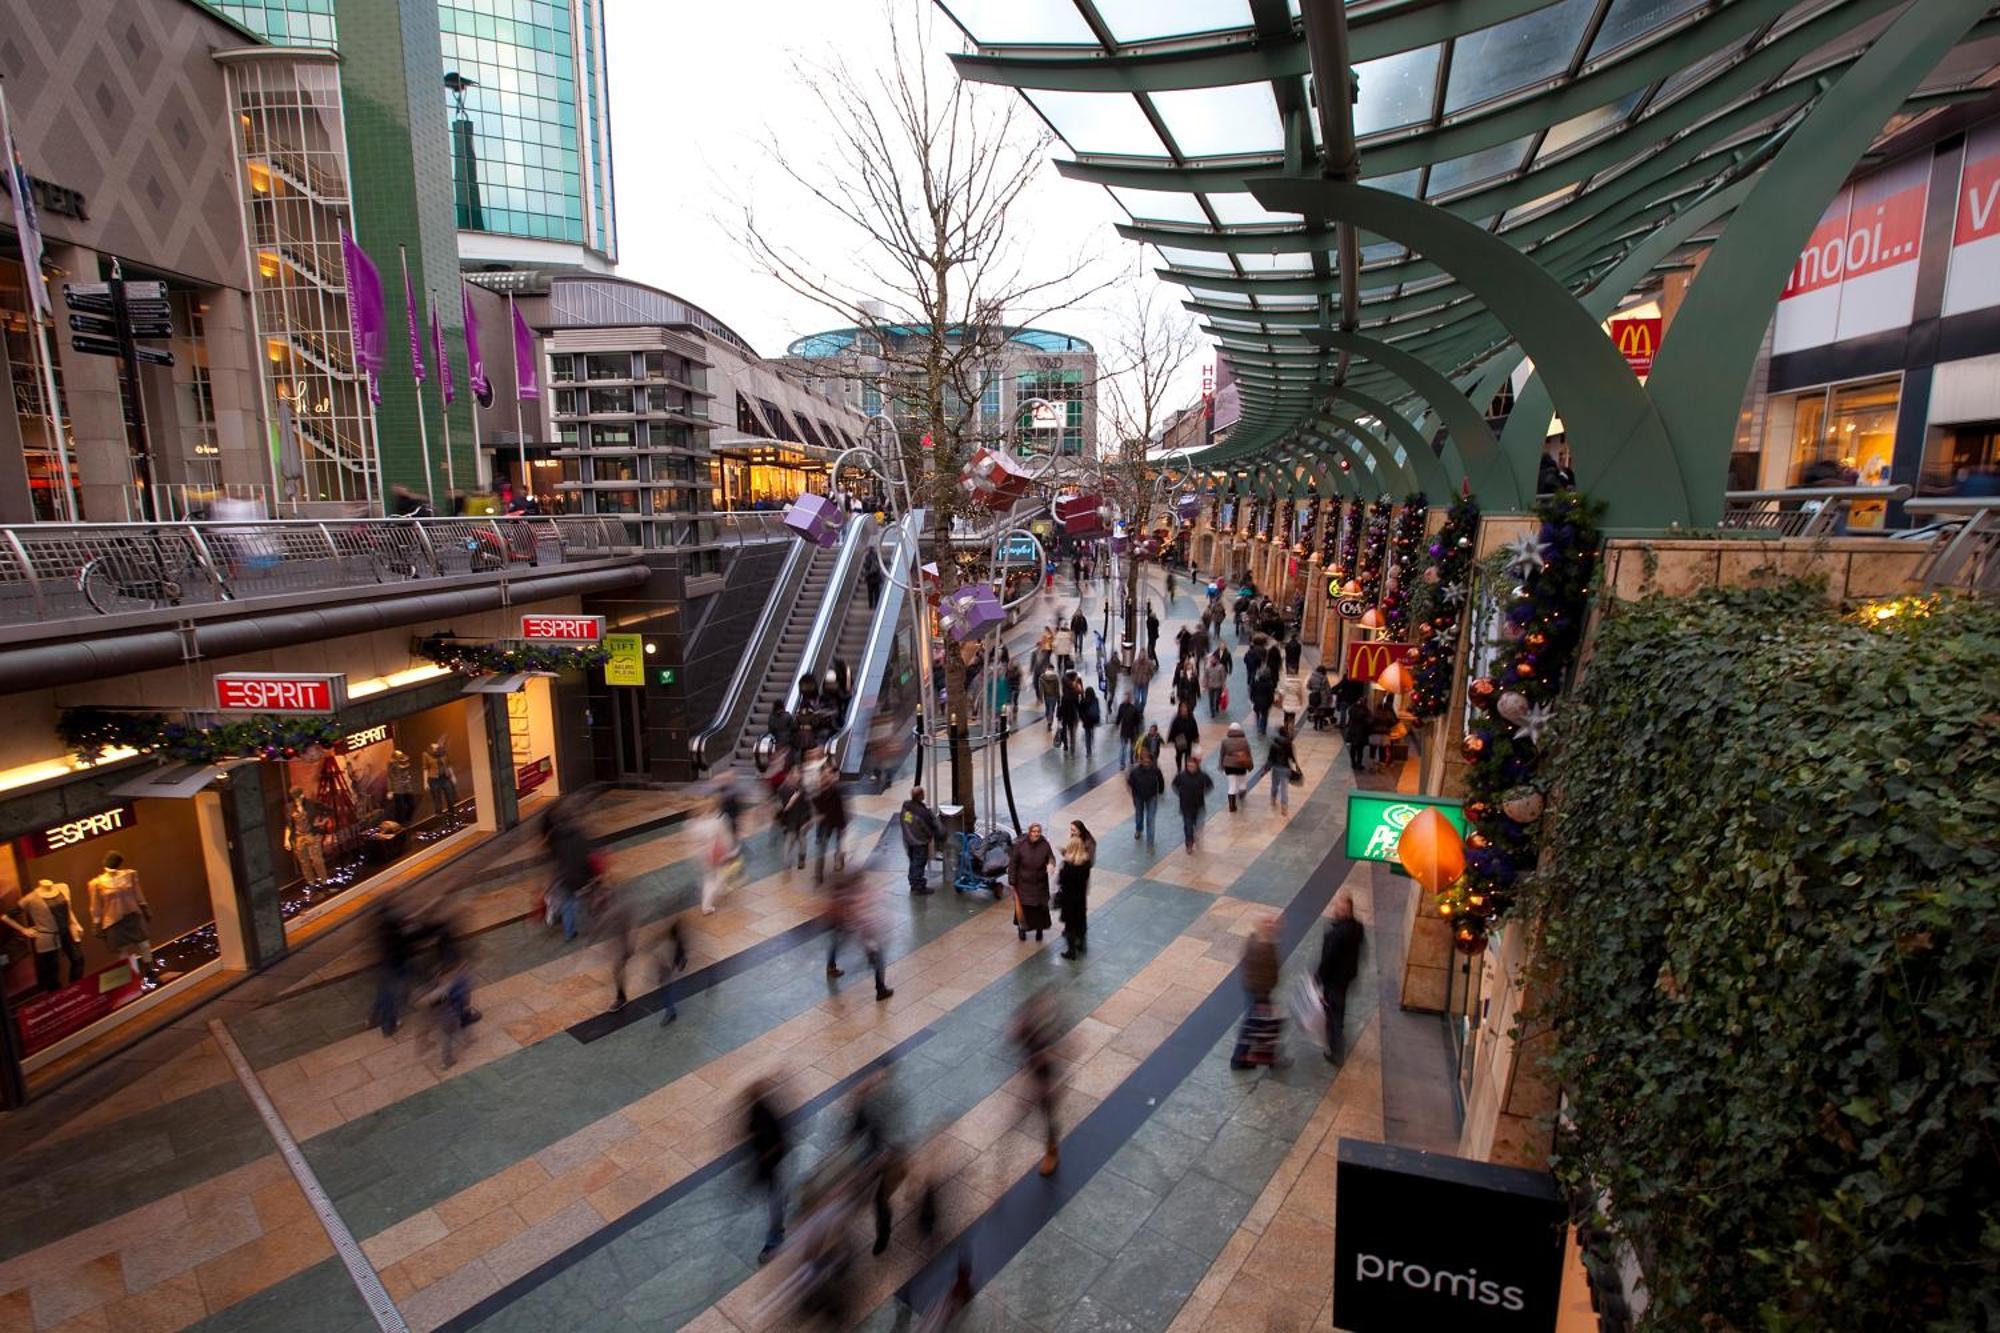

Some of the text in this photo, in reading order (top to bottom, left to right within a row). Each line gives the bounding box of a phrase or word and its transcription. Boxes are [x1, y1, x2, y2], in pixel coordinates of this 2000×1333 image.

[1341, 602, 1362, 617] C&A
[529, 619, 592, 637] ESPRIT
[226, 682, 320, 708] ESPRIT
[346, 724, 387, 750] ESPRIT
[46, 808, 124, 850] ESPRIT
[1356, 1253, 1524, 1311] promiss
